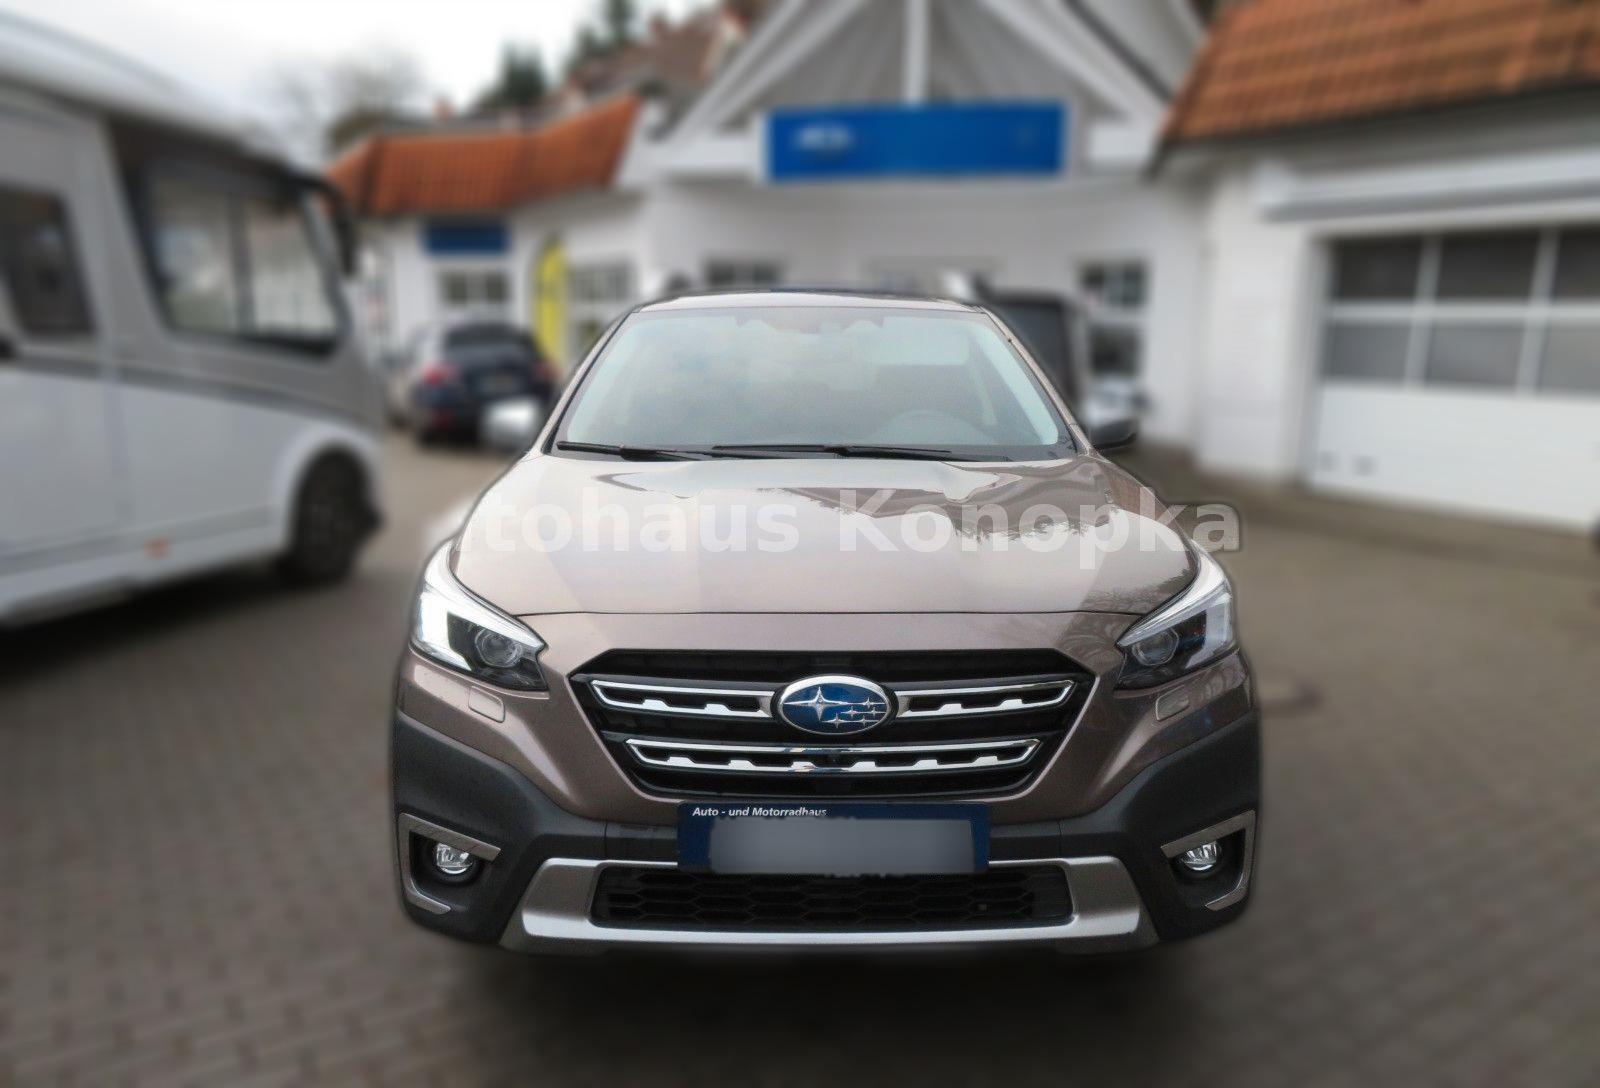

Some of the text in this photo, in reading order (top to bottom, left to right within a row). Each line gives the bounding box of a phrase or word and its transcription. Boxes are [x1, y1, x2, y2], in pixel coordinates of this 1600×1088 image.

[692, 807, 719, 817] Auto
[728, 807, 750, 817] und
[752, 807, 827, 817] Motorradhaus
